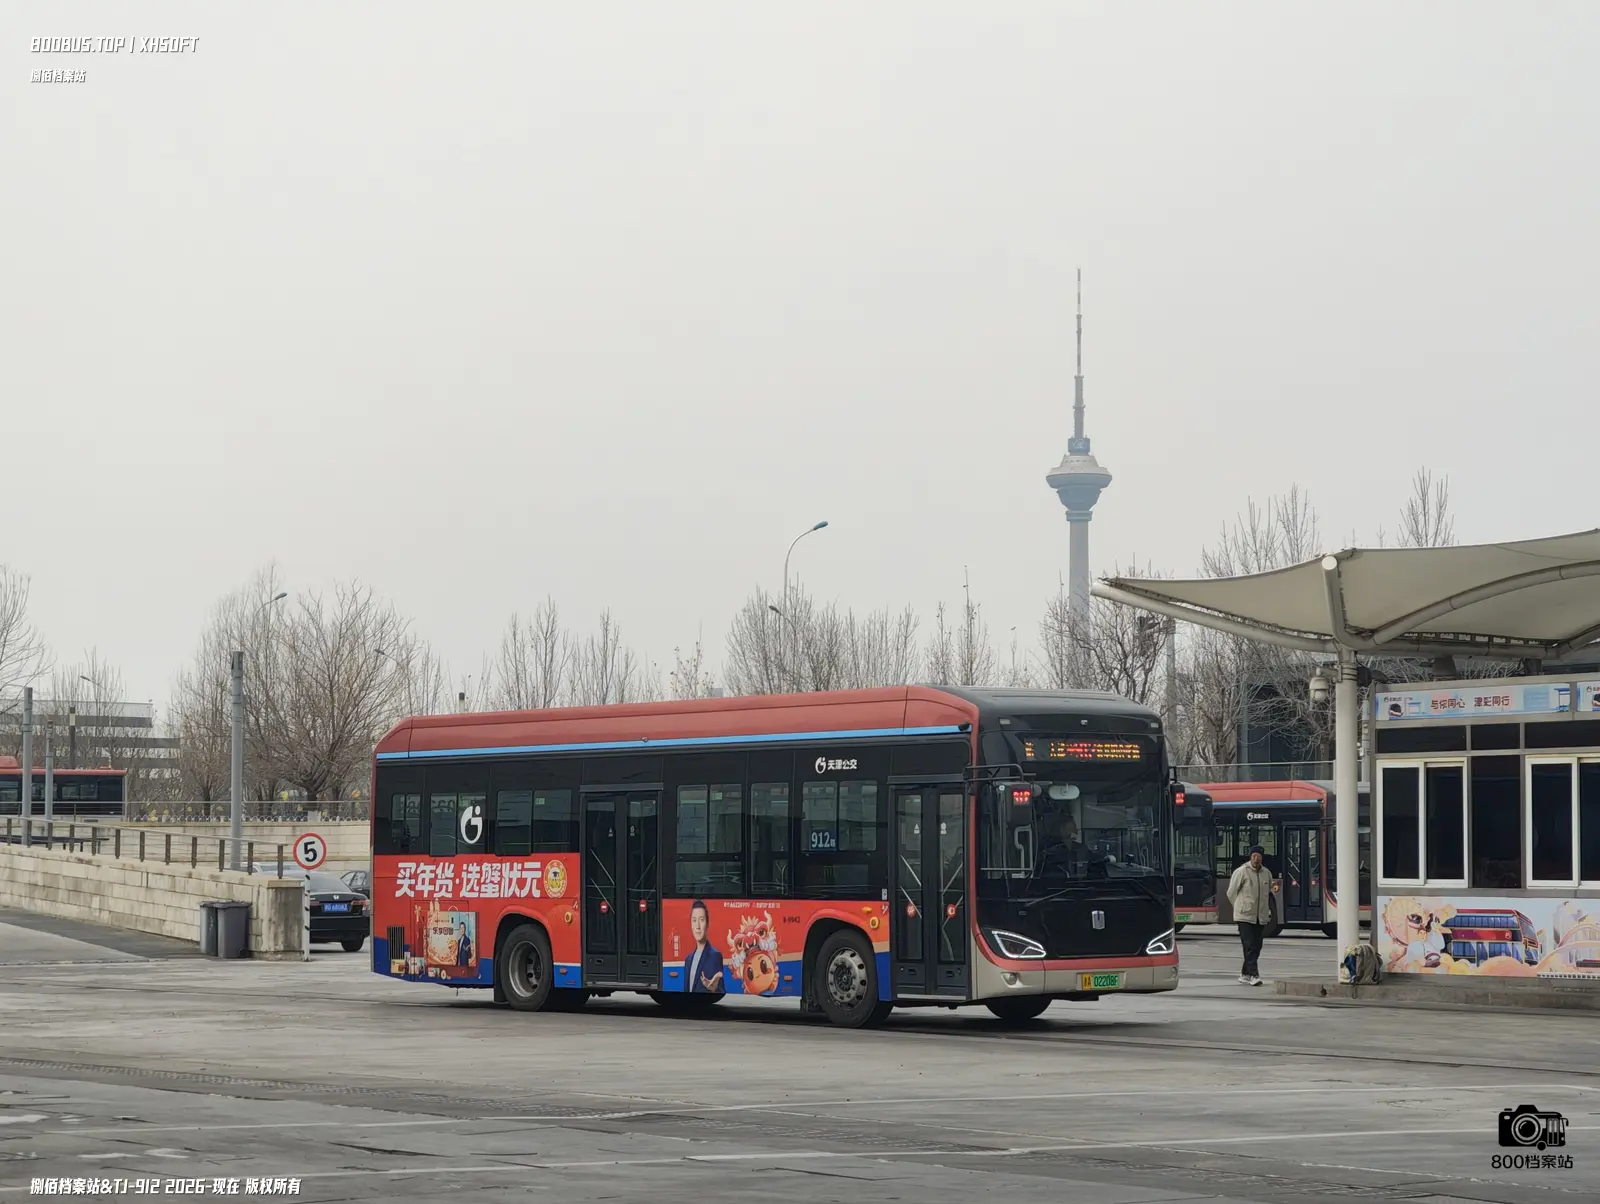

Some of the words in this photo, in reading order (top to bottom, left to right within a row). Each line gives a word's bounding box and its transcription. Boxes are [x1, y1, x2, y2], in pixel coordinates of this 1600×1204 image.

[827, 758, 858, 770] 天津公交
[303, 840, 318, 863] 5
